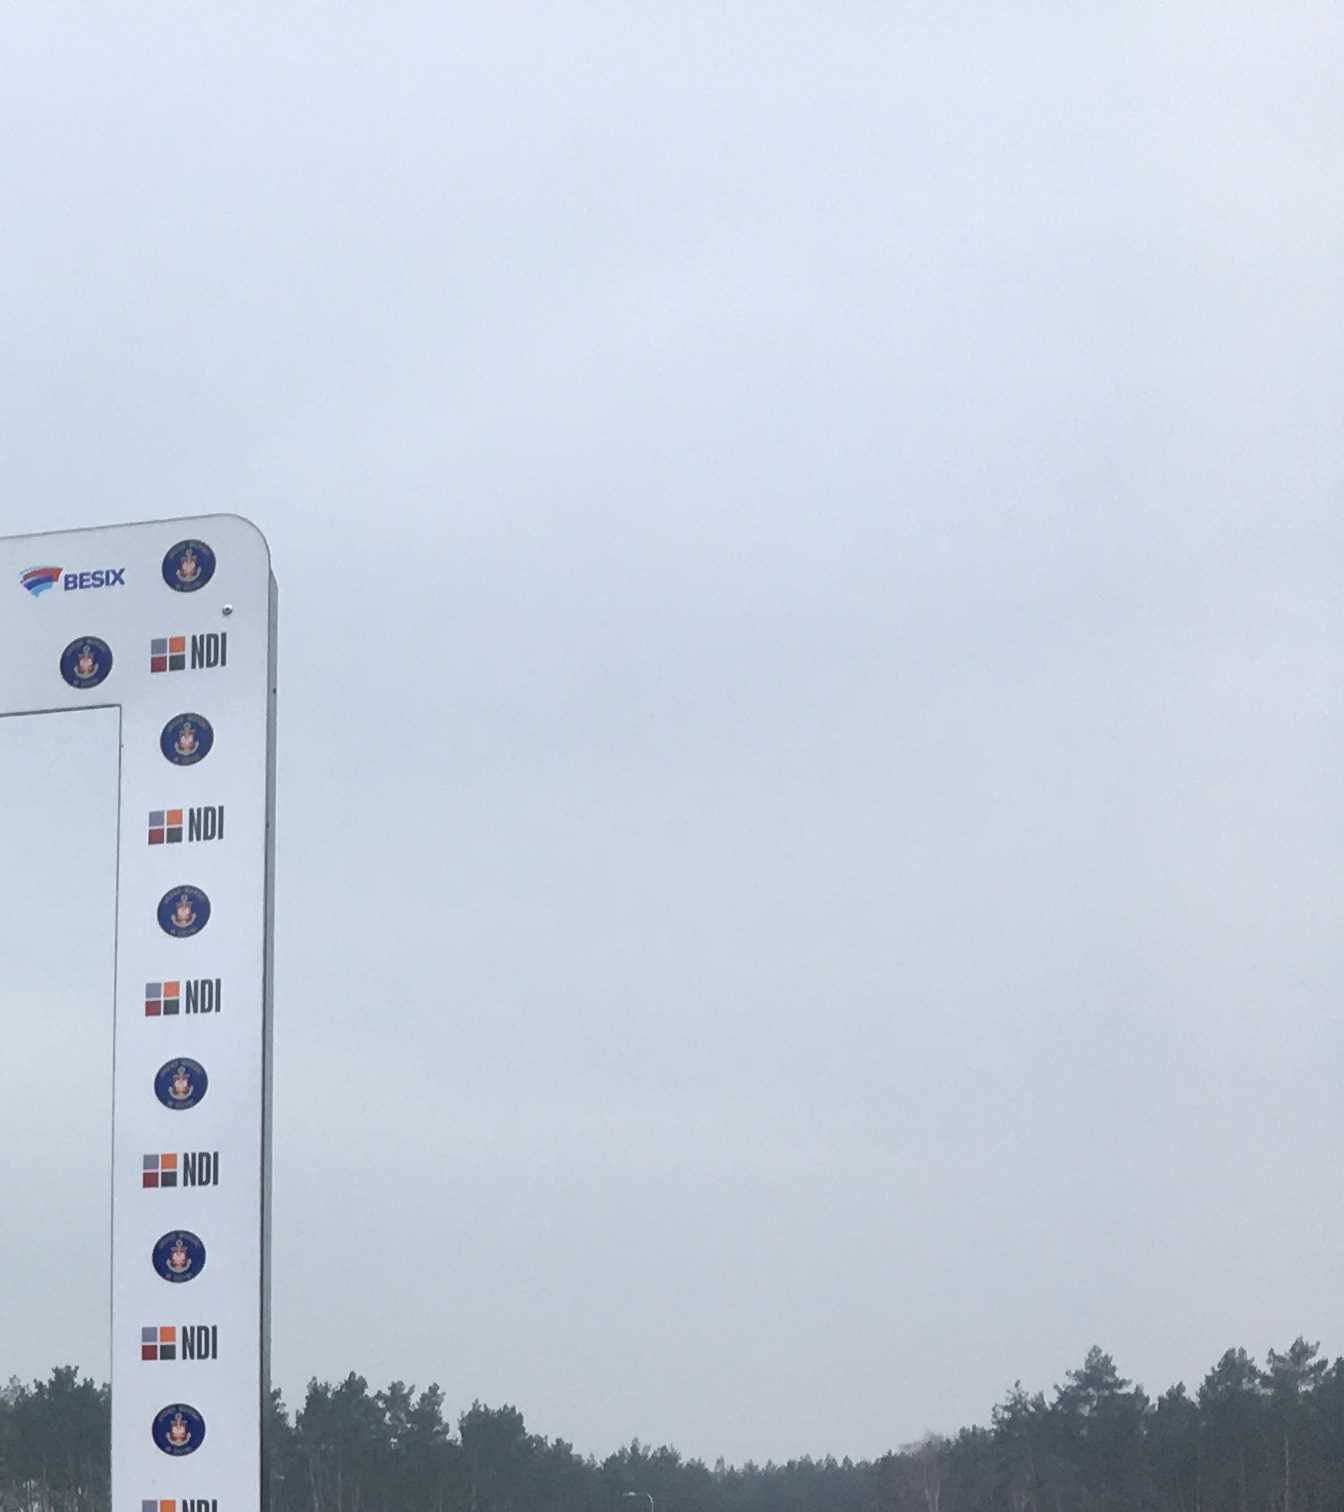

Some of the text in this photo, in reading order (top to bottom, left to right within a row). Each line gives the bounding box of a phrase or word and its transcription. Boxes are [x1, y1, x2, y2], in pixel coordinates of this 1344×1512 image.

[63, 567, 126, 592] BESIX
[190, 631, 227, 670] NDI
[188, 805, 225, 843] NDI
[185, 978, 222, 1015] NDI
[182, 1151, 219, 1188] NDI
[181, 1324, 218, 1361] NDI
